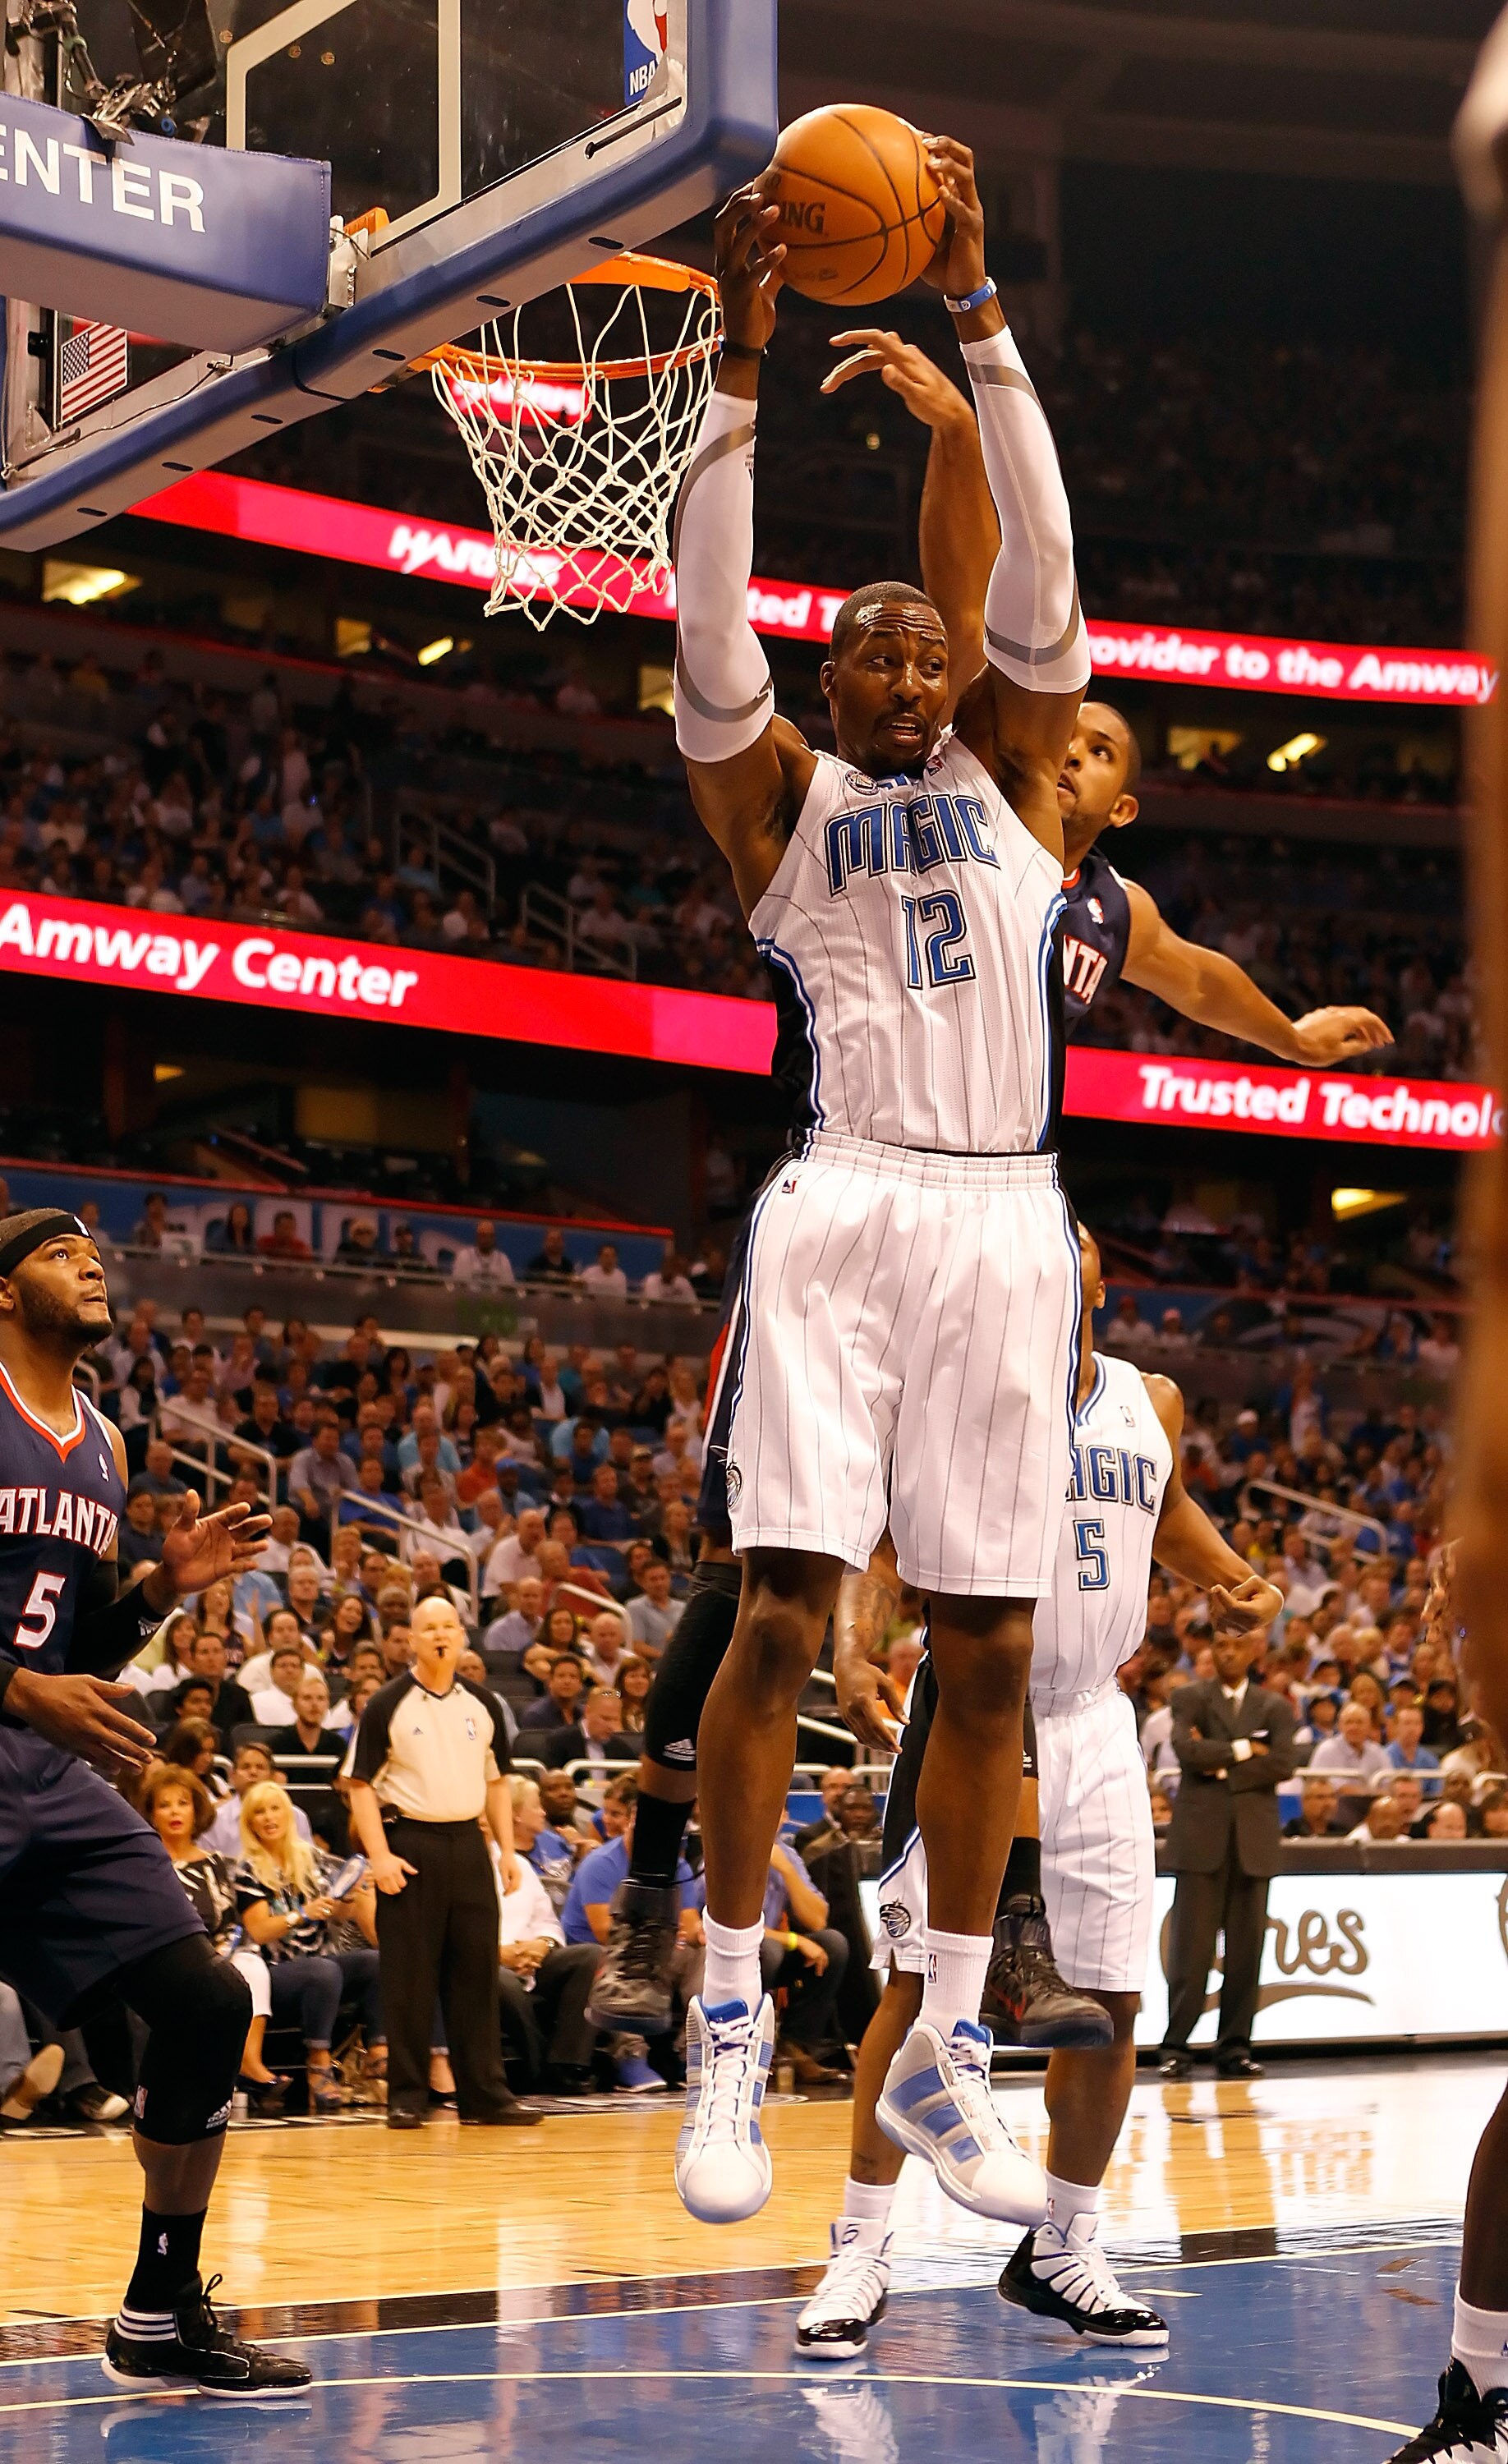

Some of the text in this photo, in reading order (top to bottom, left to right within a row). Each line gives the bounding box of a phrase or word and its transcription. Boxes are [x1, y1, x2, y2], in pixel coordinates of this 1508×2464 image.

[0, 125, 205, 232] NTER
[1225, 644, 1271, 680] to
[1277, 646, 1344, 688] the
[1348, 654, 1499, 703] Amway
[824, 794, 1001, 897] MAGIC
[0, 904, 417, 1007] Amway Center
[902, 890, 976, 990] 12
[1139, 1064, 1311, 1124] Trusted
[1065, 1444, 1158, 1516] AGIC
[0, 1487, 118, 1557] ATLANTA
[1072, 1519, 1110, 1591] 5
[13, 1570, 67, 1650] 5
